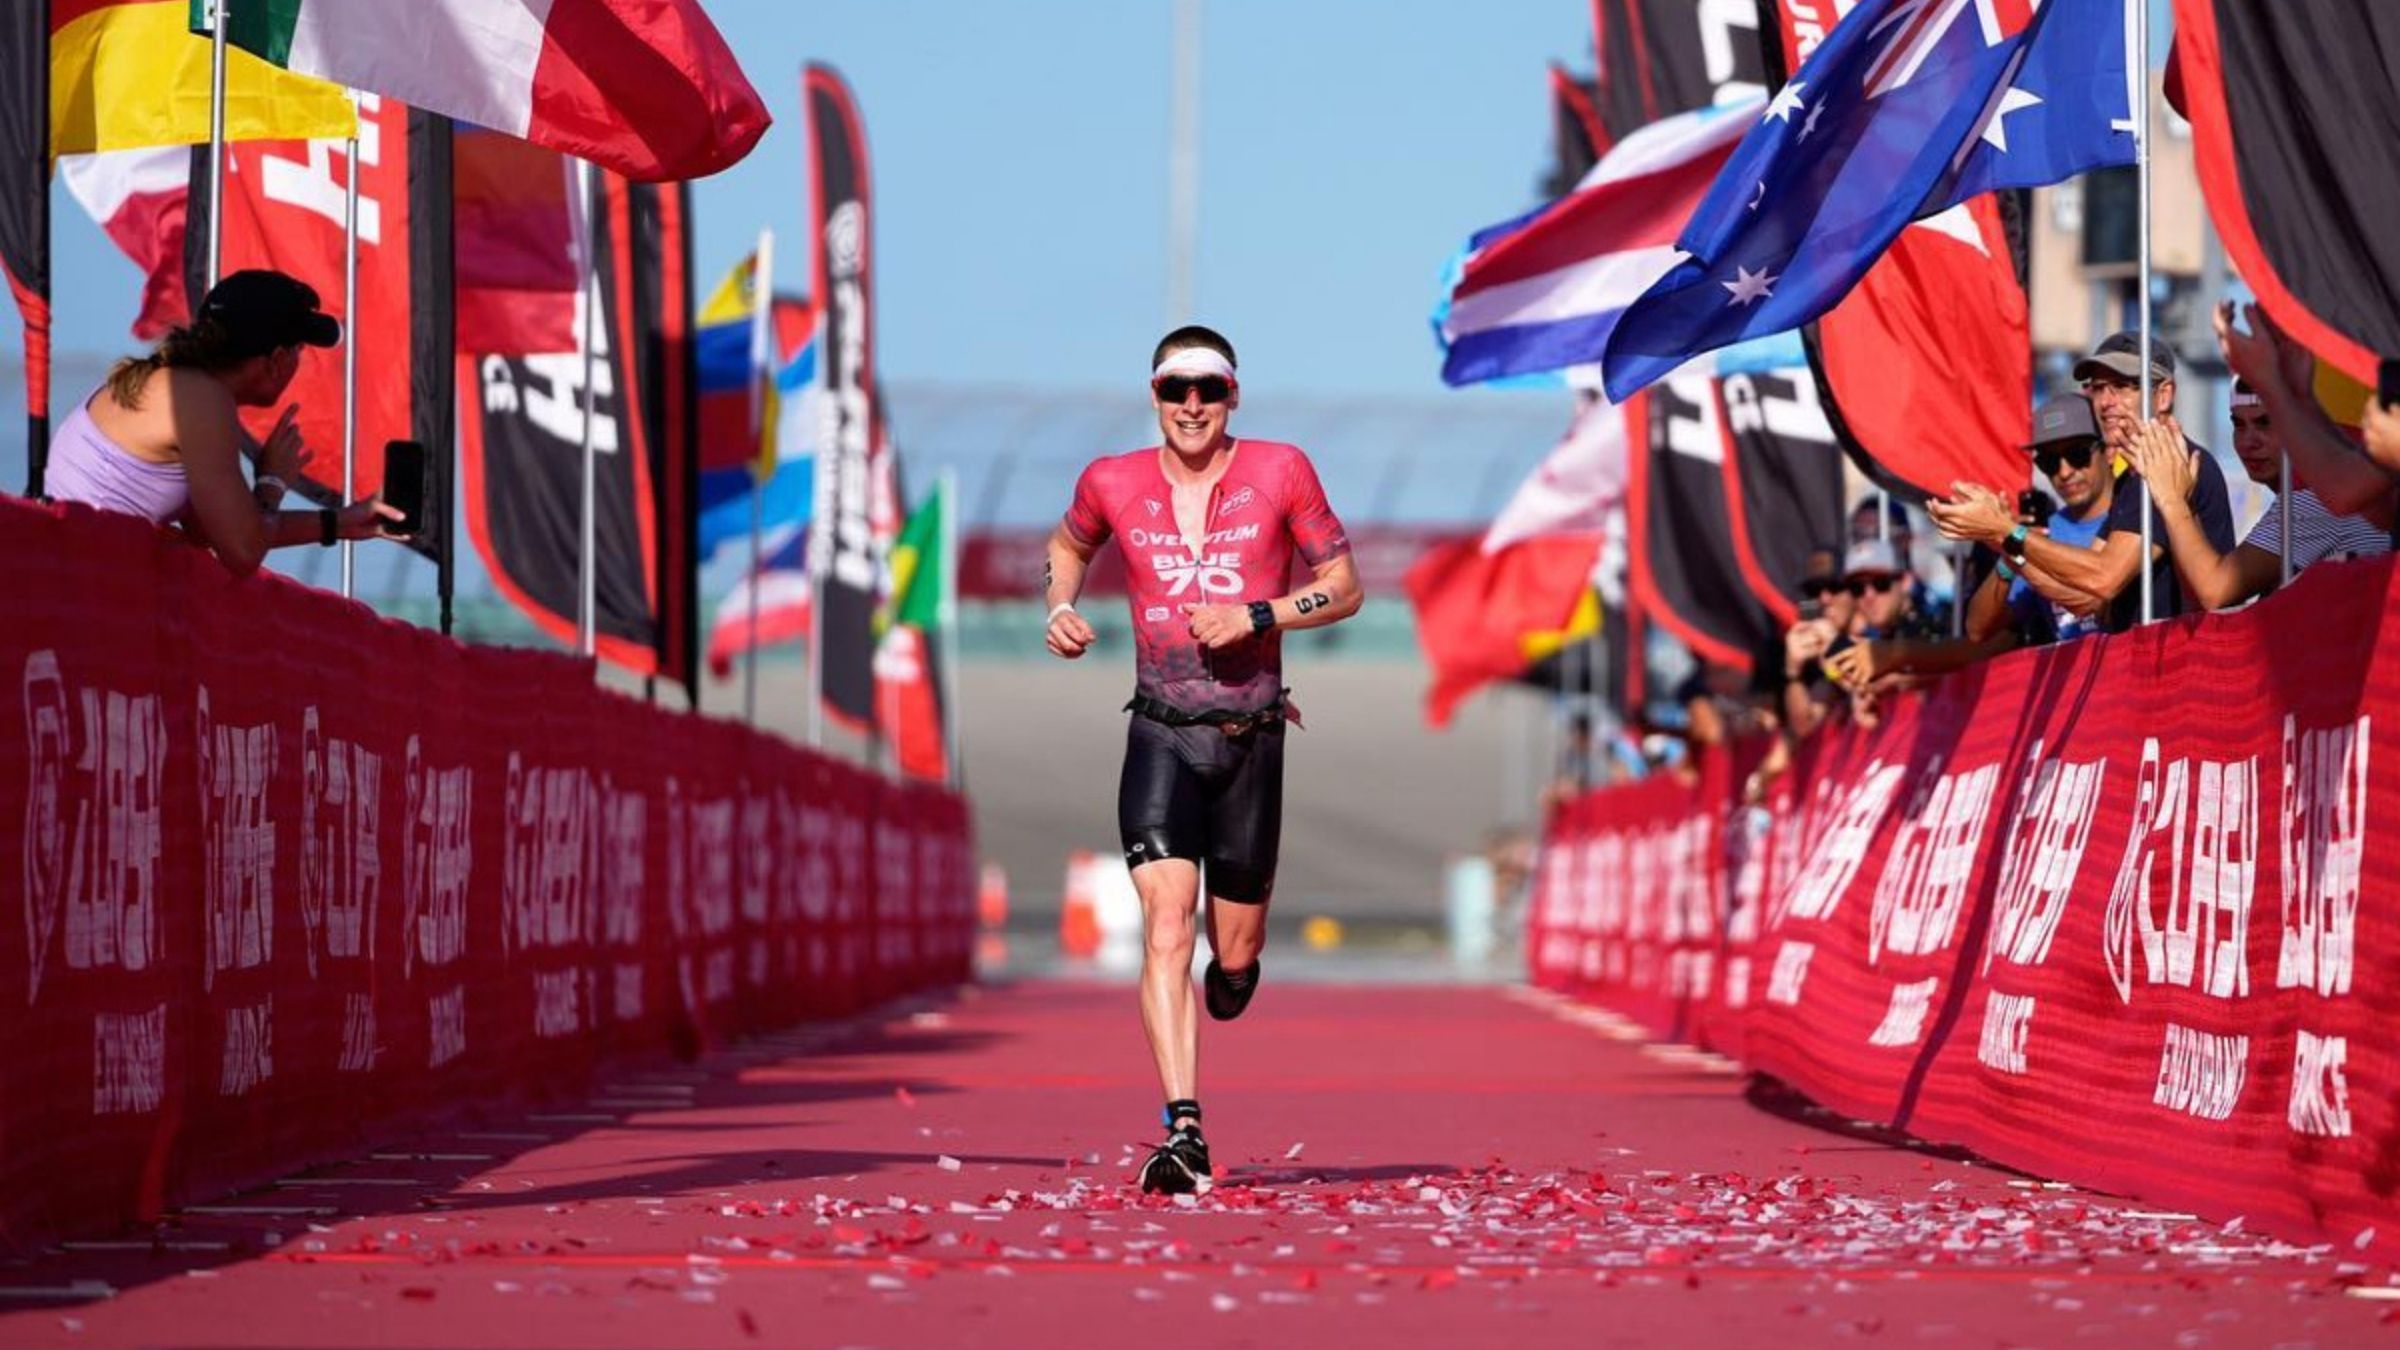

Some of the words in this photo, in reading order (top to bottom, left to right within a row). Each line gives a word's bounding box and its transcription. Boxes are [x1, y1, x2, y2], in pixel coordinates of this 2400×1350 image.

[1152, 552, 1241, 570] BLUE
[1156, 566, 1244, 596] 70
[1295, 592, 1330, 615] 49
